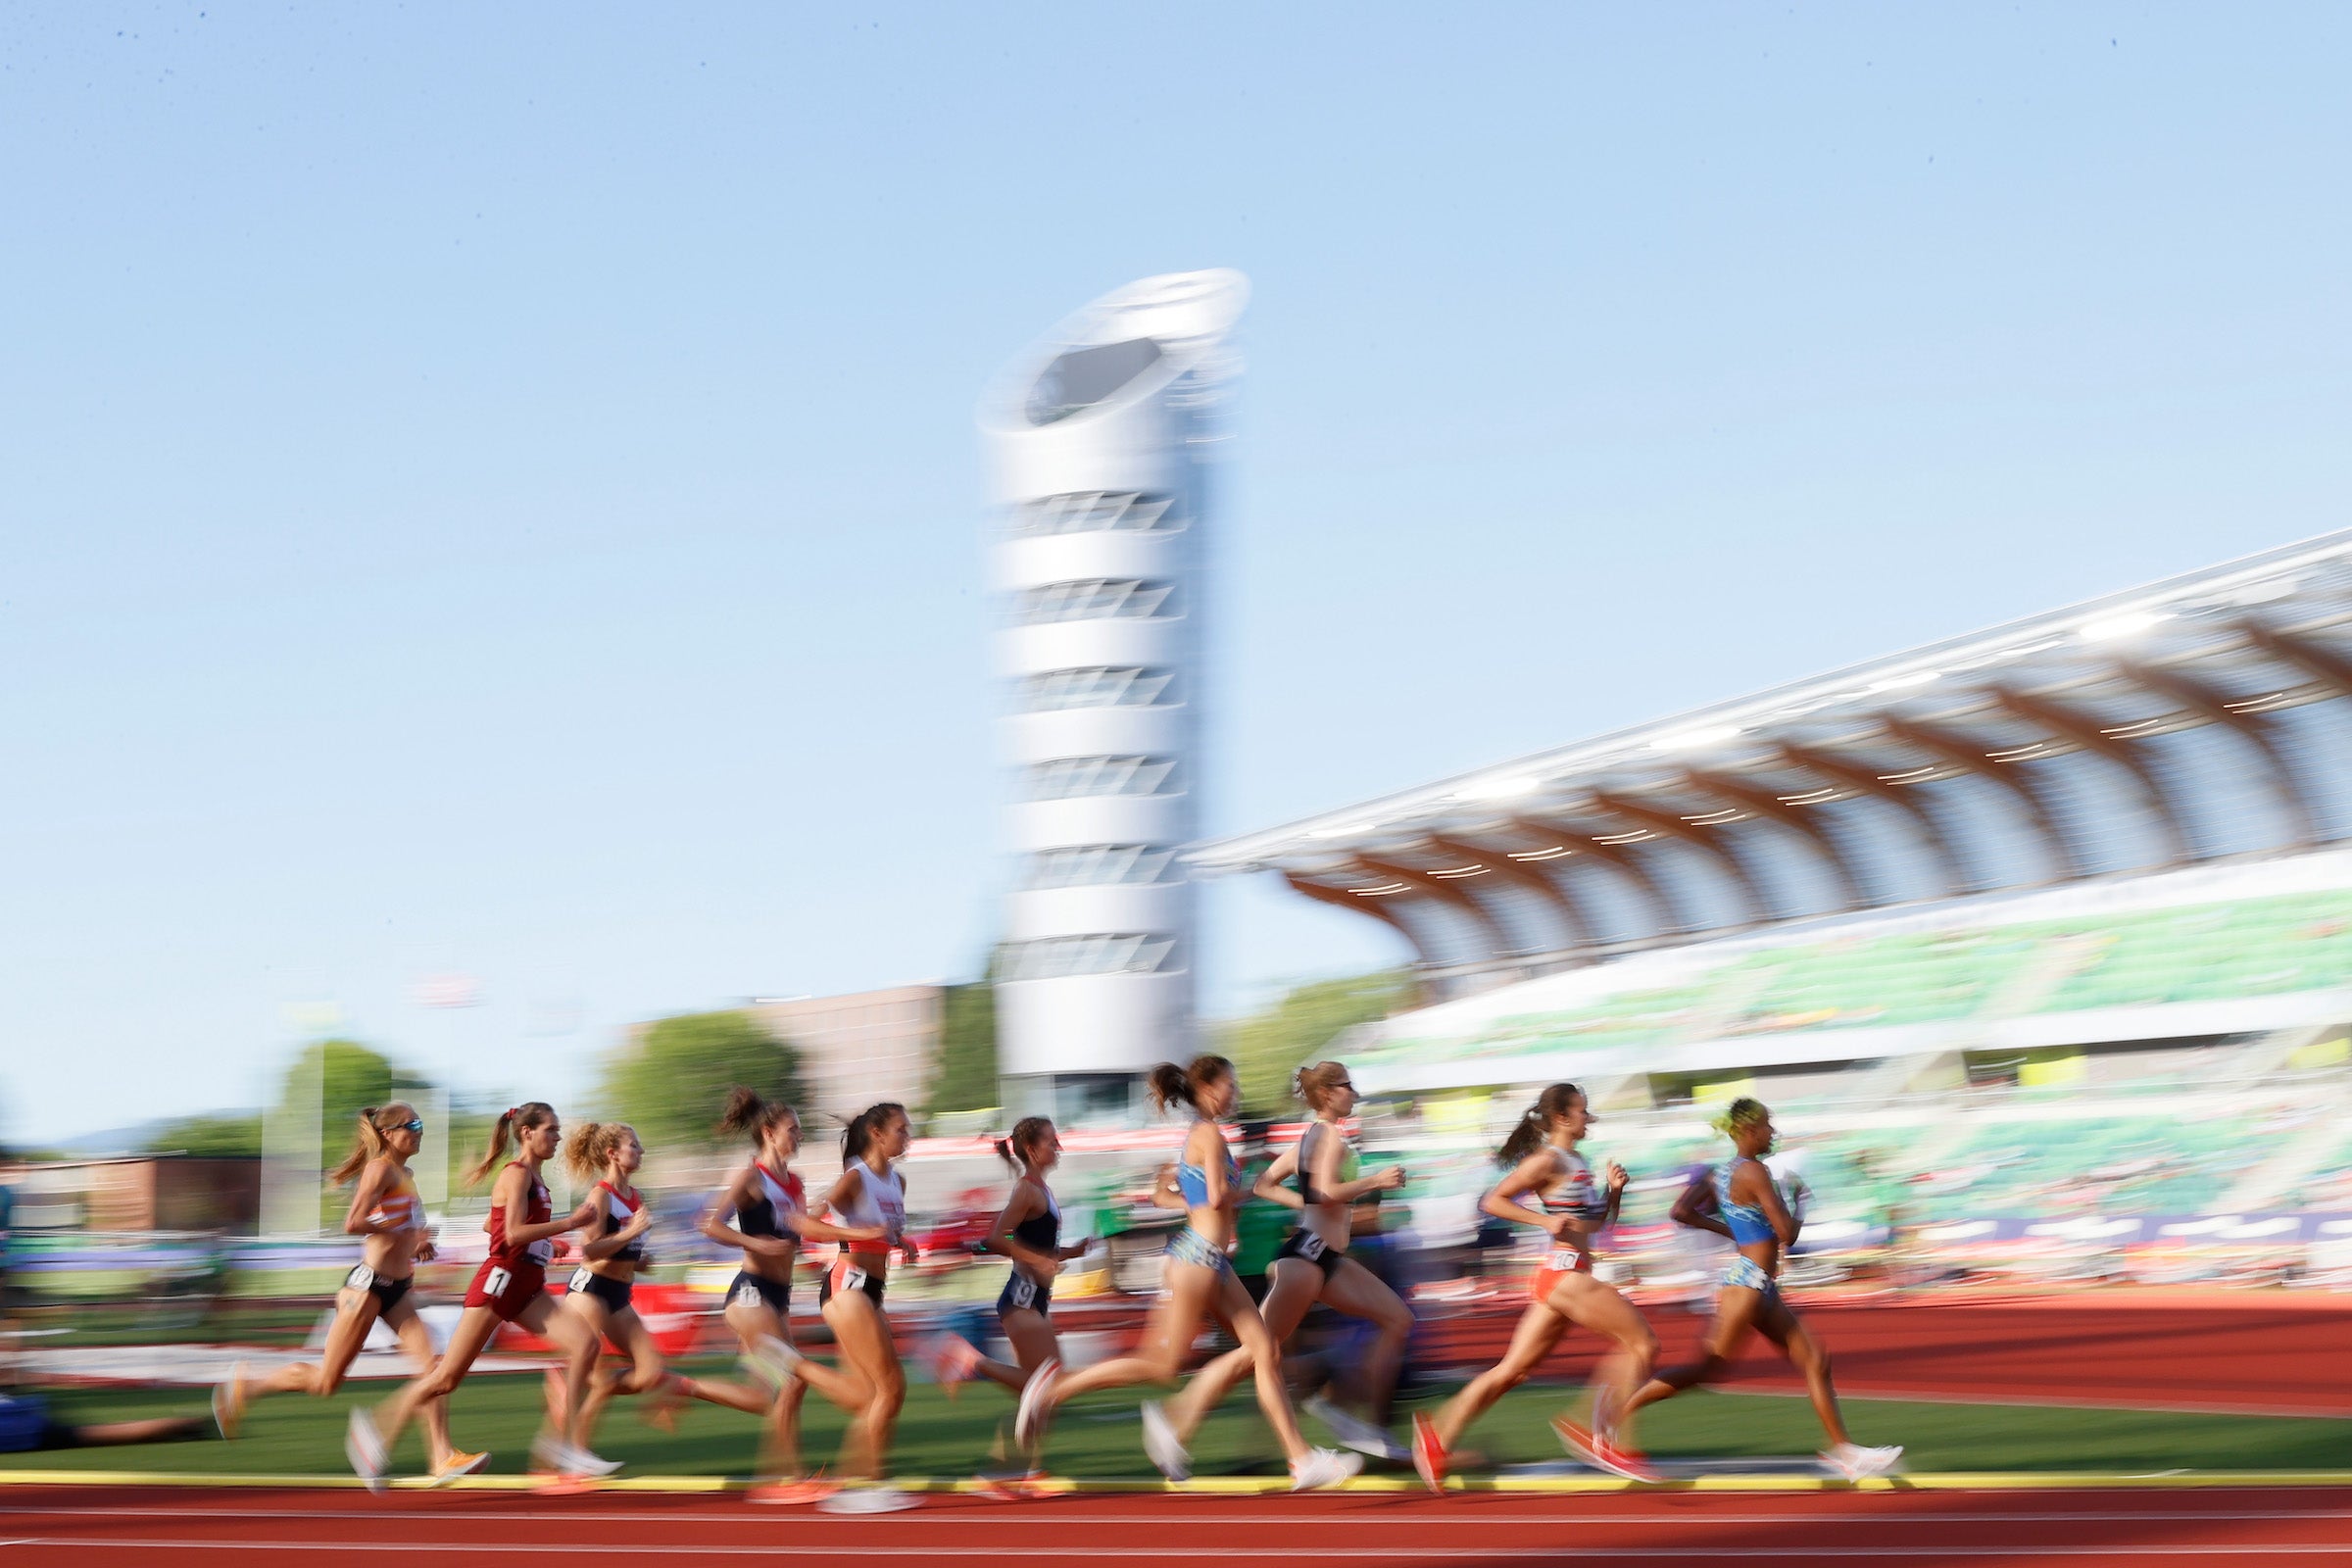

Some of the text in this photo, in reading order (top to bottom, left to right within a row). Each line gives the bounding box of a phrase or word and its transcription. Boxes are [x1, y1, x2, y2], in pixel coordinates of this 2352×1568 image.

[1307, 1238, 1324, 1255] 4
[1556, 1253, 1576, 1268] 10
[493, 1273, 506, 1295] 1
[574, 1268, 588, 1290] 2
[849, 1270, 862, 1290] 7
[1018, 1283, 1032, 1305] 9
